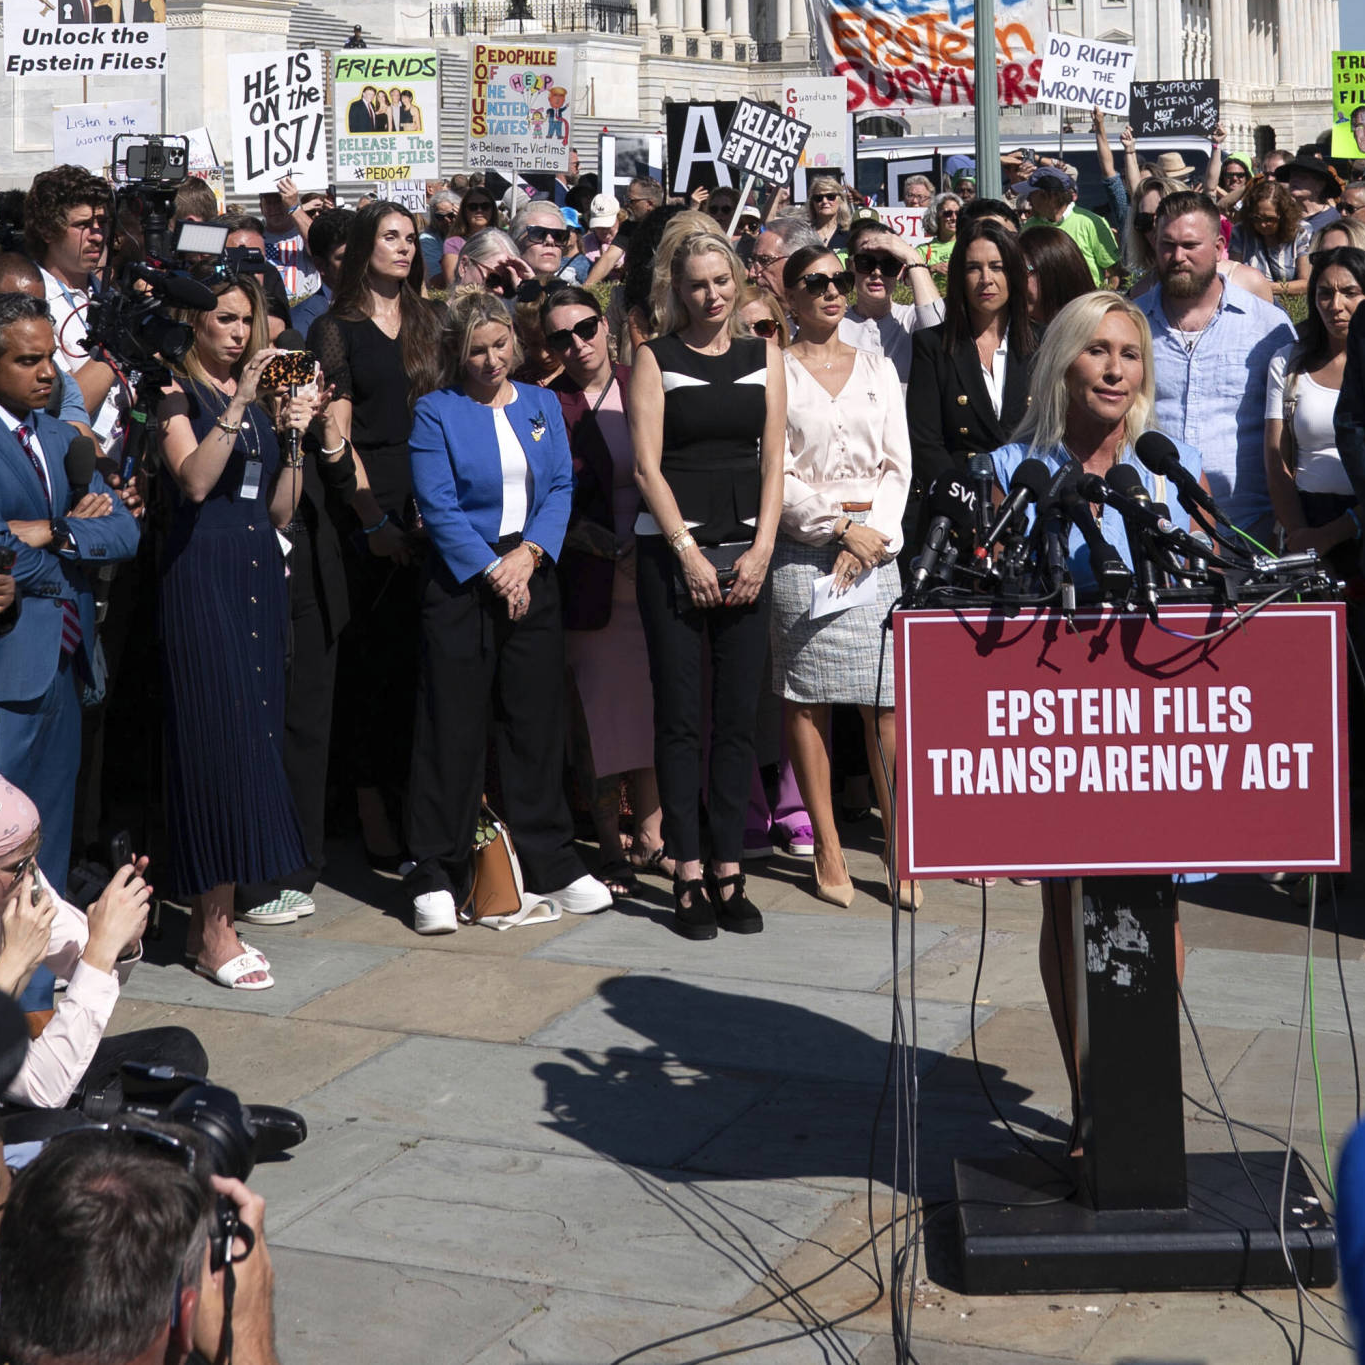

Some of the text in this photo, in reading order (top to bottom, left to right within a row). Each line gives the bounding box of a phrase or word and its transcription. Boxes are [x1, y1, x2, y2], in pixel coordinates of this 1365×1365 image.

[22, 27, 149, 45] Unlock the
[1050, 39, 1133, 68] DO RIGHT
[6, 52, 167, 76] Epstein Files!
[335, 57, 436, 79] FRIENDS
[243, 52, 311, 104] HE IS
[512, 75, 552, 91] HELP
[1062, 65, 1116, 83] BY THE
[1338, 73, 1350, 84] IS
[1041, 80, 1127, 109] WRONGED
[1133, 81, 1204, 98] WE SUPPORT
[250, 85, 320, 126] ON the
[1144, 95, 1196, 110] VICTEMS
[66, 115, 135, 129] Listen to the
[1154, 108, 1175, 120] NOT
[733, 101, 808, 155] RELEASE
[245, 113, 323, 180] LIST!
[338, 136, 433, 151] RELEASE The
[470, 142, 565, 155] #Believe The Victims
[339, 151, 435, 166] EPSTEIN FILES
[470, 155, 559, 169] #Release The Files
[721, 132, 794, 184] THE FILES
[354, 166, 411, 180] #PEDO47
[948, 482, 977, 511] svt
[987, 686, 1252, 736] EPSTEIN FILES
[928, 743, 1314, 796] TRANSPARENCY ACT
